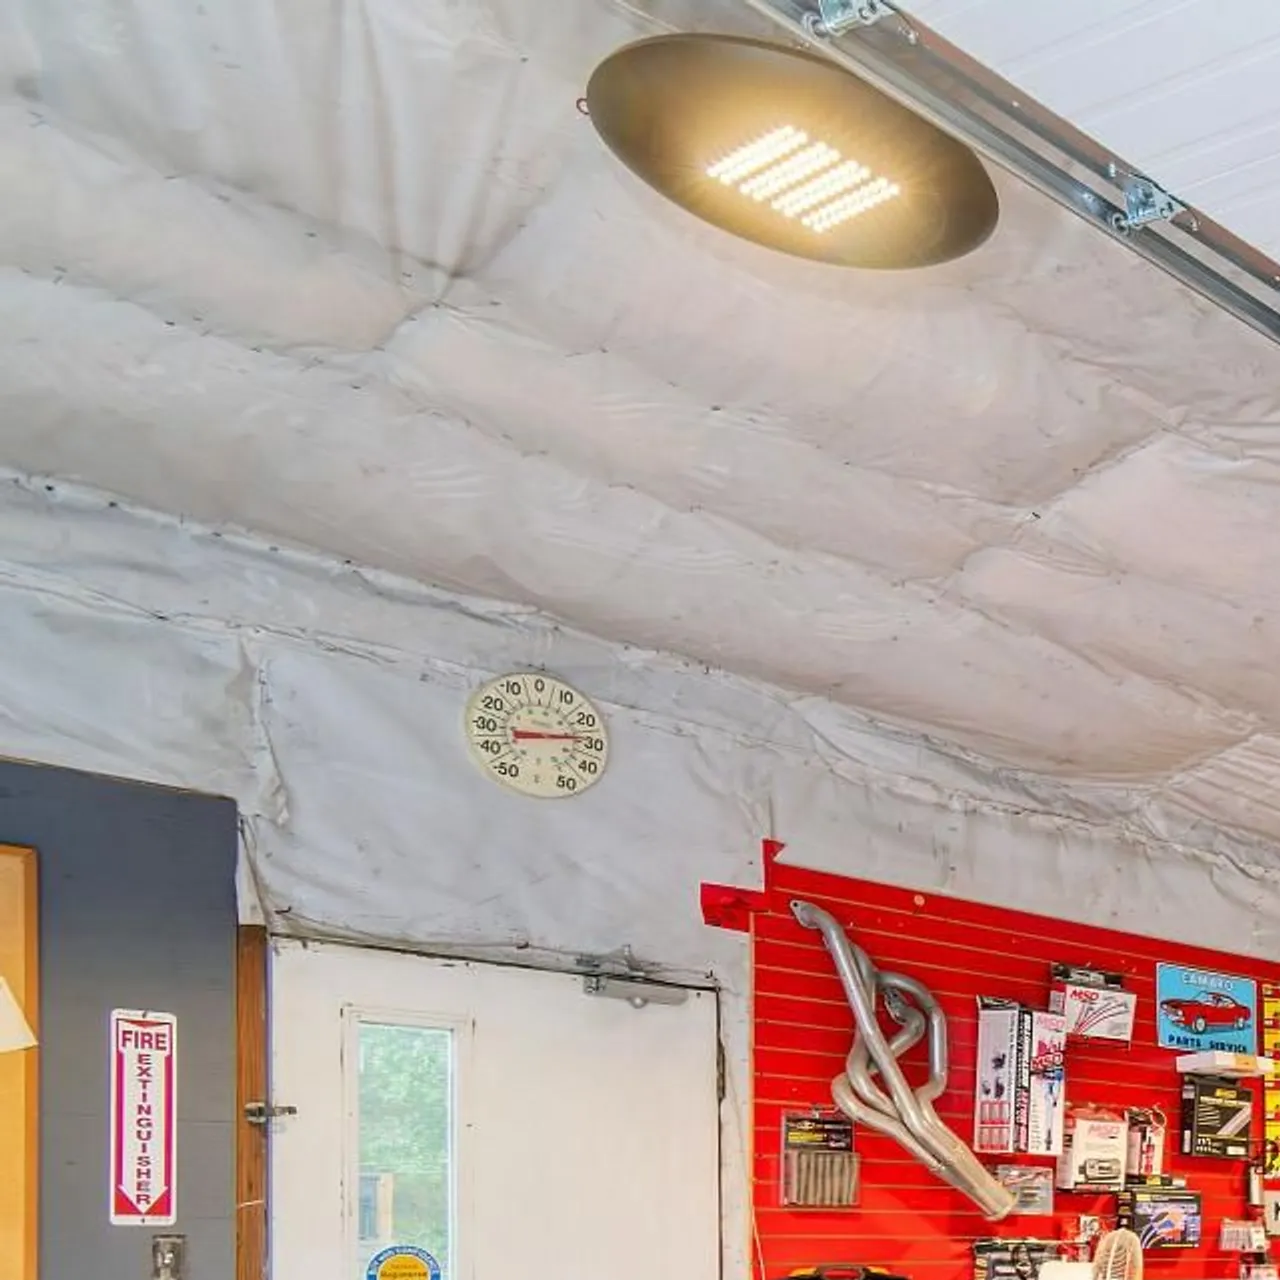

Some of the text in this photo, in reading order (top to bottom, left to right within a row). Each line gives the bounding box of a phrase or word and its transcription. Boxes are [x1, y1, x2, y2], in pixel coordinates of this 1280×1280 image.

[500, 680, 521, 695] -10
[534, 679, 545, 692] 0
[560, 690, 573, 704] 10
[472, 716, 497, 732] -30
[577, 712, 595, 727] 20
[584, 736, 604, 751] 30
[494, 762, 519, 777] -50
[578, 760, 597, 774] 40
[556, 776, 576, 790] 50
[121, 1030, 167, 1051] FIRE
[136, 1053, 152, 1205] EXTINGUISHER
